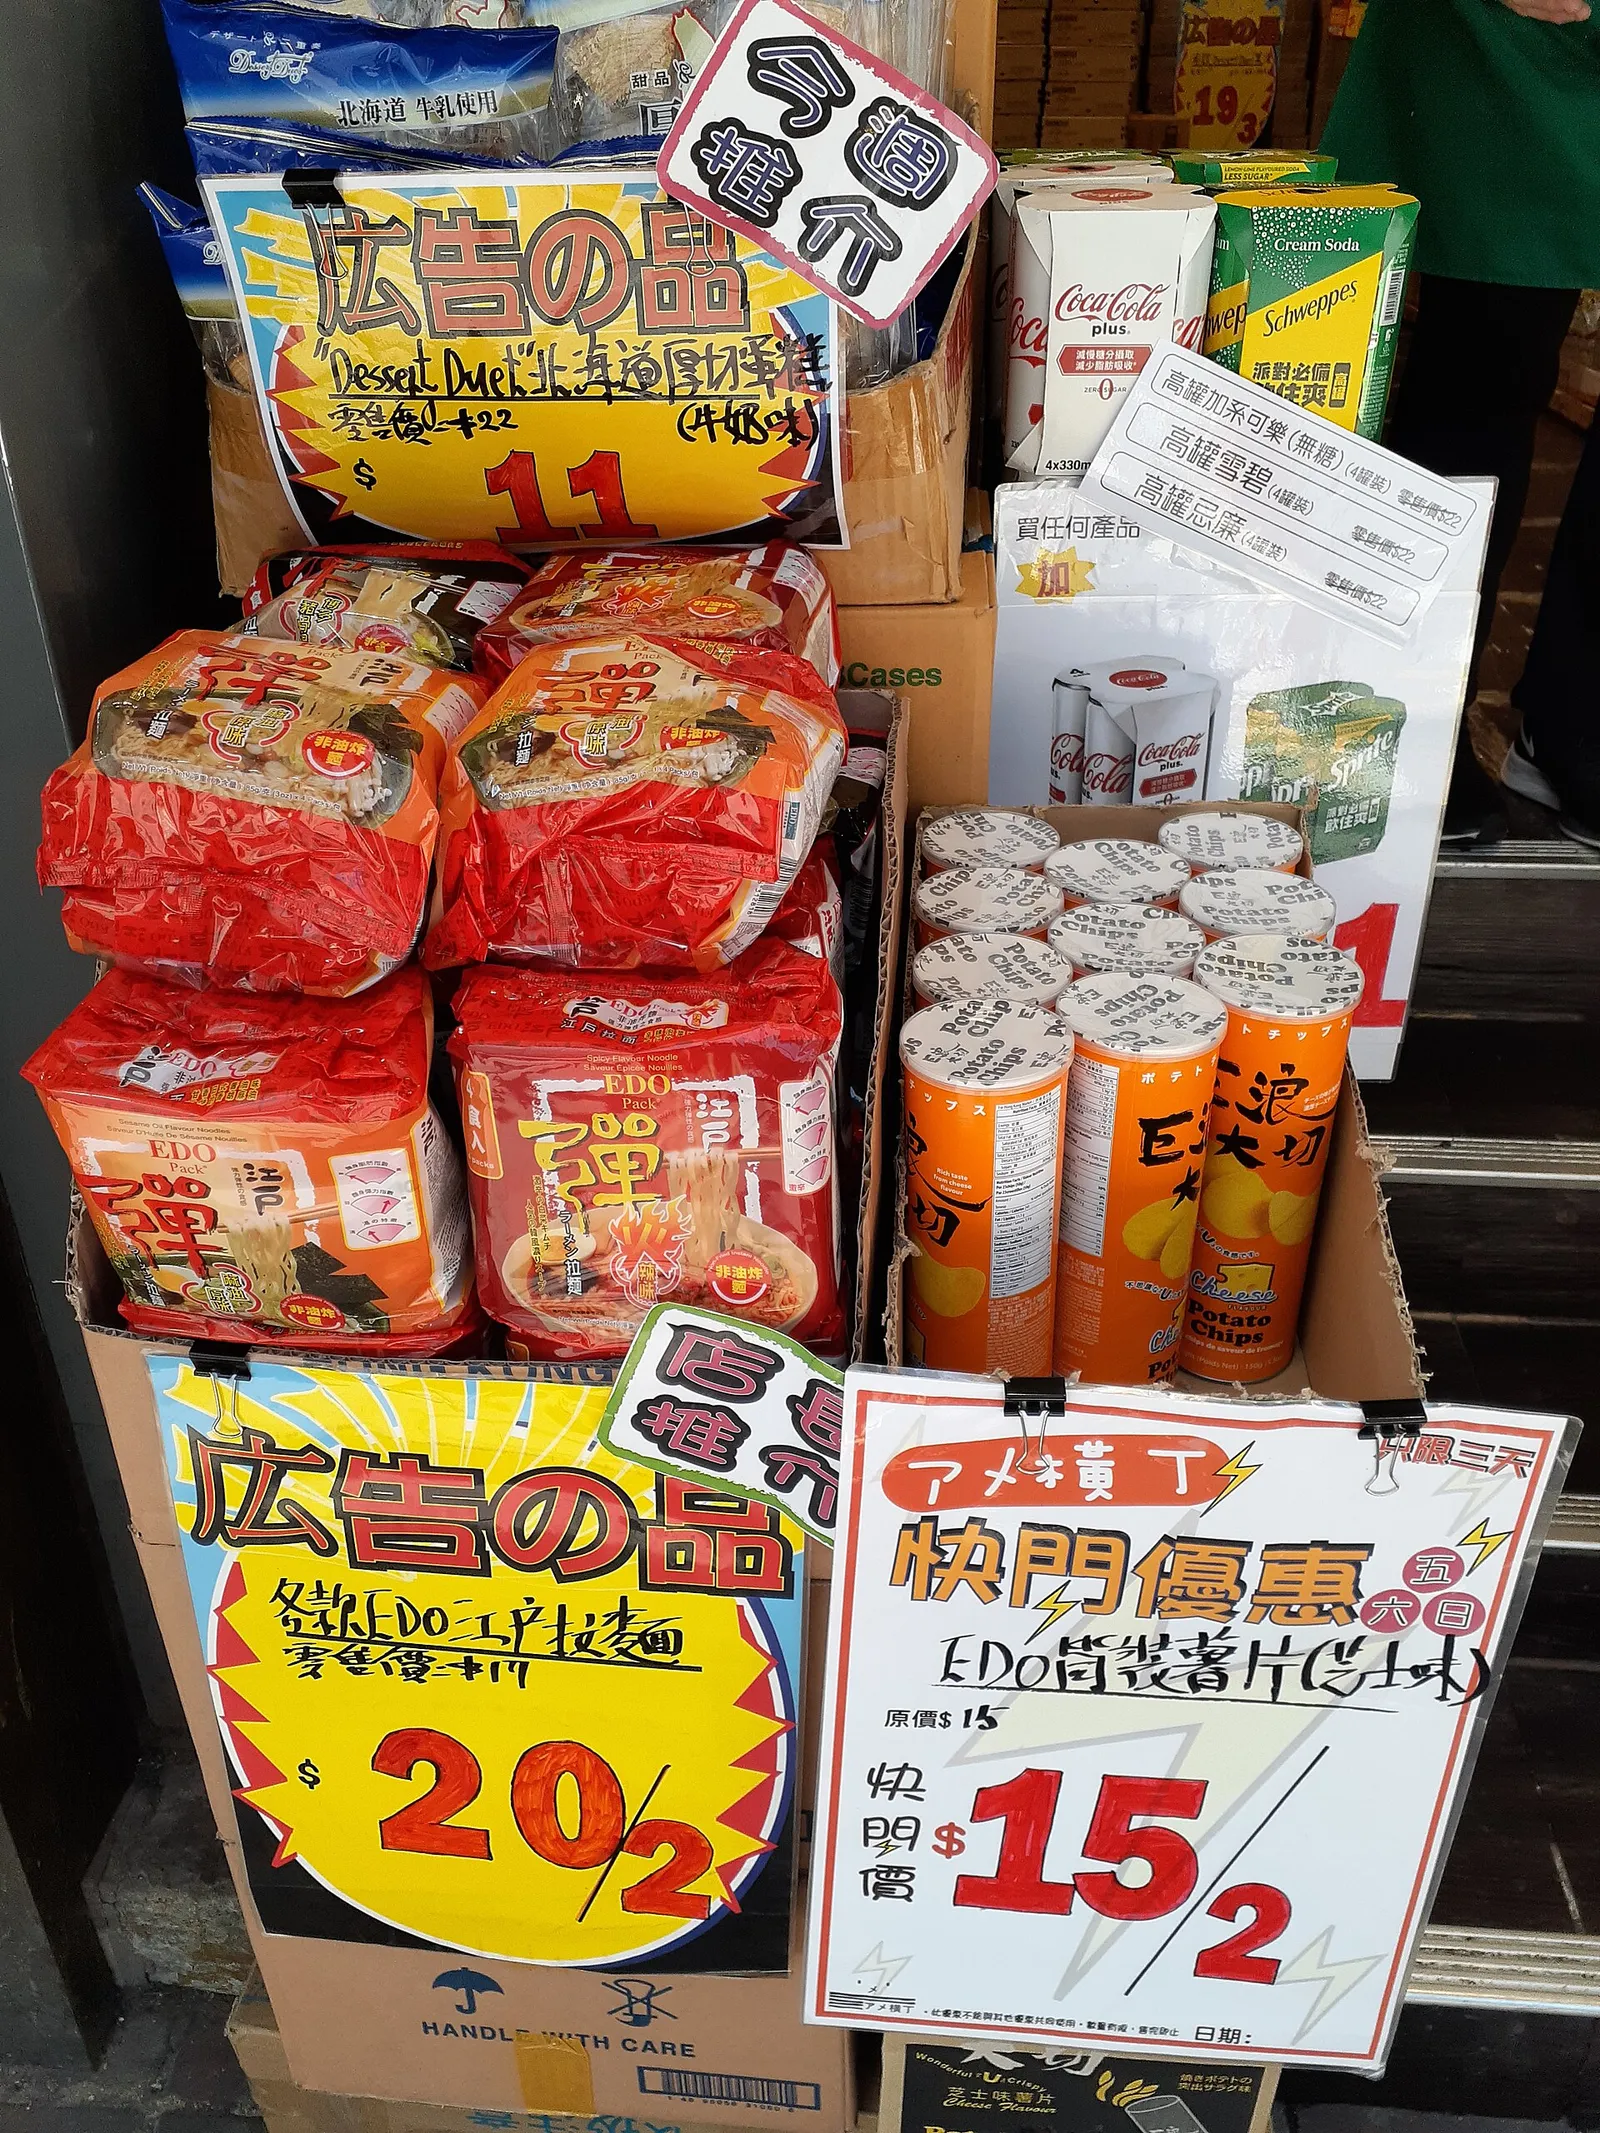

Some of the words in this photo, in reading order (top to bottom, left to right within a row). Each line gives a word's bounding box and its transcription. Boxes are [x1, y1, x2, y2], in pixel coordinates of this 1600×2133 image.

[631, 70, 670, 88] 甜品
[336, 97, 407, 127] 北海道
[415, 89, 499, 120] 牛乳使用
[1224, 173, 1242, 181] LESS
[1273, 237, 1323, 252] Cream
[1324, 237, 1360, 252] Soda
[305, 203, 750, 340] 広告の品
[1054, 282, 1171, 323] Coca-Cola
[1262, 279, 1358, 338] Schweppes
[1252, 361, 1331, 382] 派對必備
[1159, 423, 1274, 497] 高罐雪碧
[353, 458, 377, 491] $
[484, 448, 659, 545] 11
[1132, 471, 1248, 544] 高罐忌廉
[1015, 514, 1141, 542] 買任何產品
[313, 734, 368, 756] 非油炸
[987, 953, 1034, 991] Chips
[1002, 941, 1058, 986] Potato
[1197, 962, 1296, 987] Potato
[1203, 951, 1287, 974] Chips
[1093, 983, 1159, 1018] Chips
[1109, 989, 1186, 1028] Potato
[586, 1054, 611, 1064] Spicy
[612, 1054, 645, 1063] Flavour
[646, 1053, 679, 1062] Noodle
[947, 1038, 1006, 1085] Potato
[976, 1046, 1029, 1087] Chips
[603, 1073, 672, 1096] EDO
[622, 1096, 657, 1111] Pack
[148, 1138, 217, 1164] EDO
[169, 1161, 206, 1175] Pack
[518, 1112, 664, 1237] 彈
[932, 1173, 949, 1186] from
[948, 1178, 973, 1191] cheese
[935, 1167, 950, 1179] Rich
[950, 1172, 969, 1183] taste
[939, 1185, 965, 1197] flavour
[715, 1263, 764, 1281] 非油炸
[1188, 1267, 1279, 1306] Cheese
[1187, 1299, 1273, 1329] Potato
[1190, 1319, 1265, 1348] Chips
[187, 1423, 796, 1600] 広告の品
[889, 1514, 1376, 1630] 快門優惠
[1410, 1554, 1457, 1586] 五
[1367, 1597, 1413, 1627] 六
[1436, 1600, 1475, 1628] 日
[884, 1707, 954, 1730] 原價$
[297, 1759, 321, 1791] $
[932, 1821, 966, 1859] $
[620, 2037, 697, 2060] CARE
[1193, 2024, 1254, 2047] 日期:
[914, 2051, 973, 2079] Wonderful
[946, 2086, 1057, 2106] 芝士味薯片
[1006, 2076, 1048, 2093] Crispy
[941, 2097, 993, 2111] Cheese
[998, 2101, 1058, 2115] Flavour
